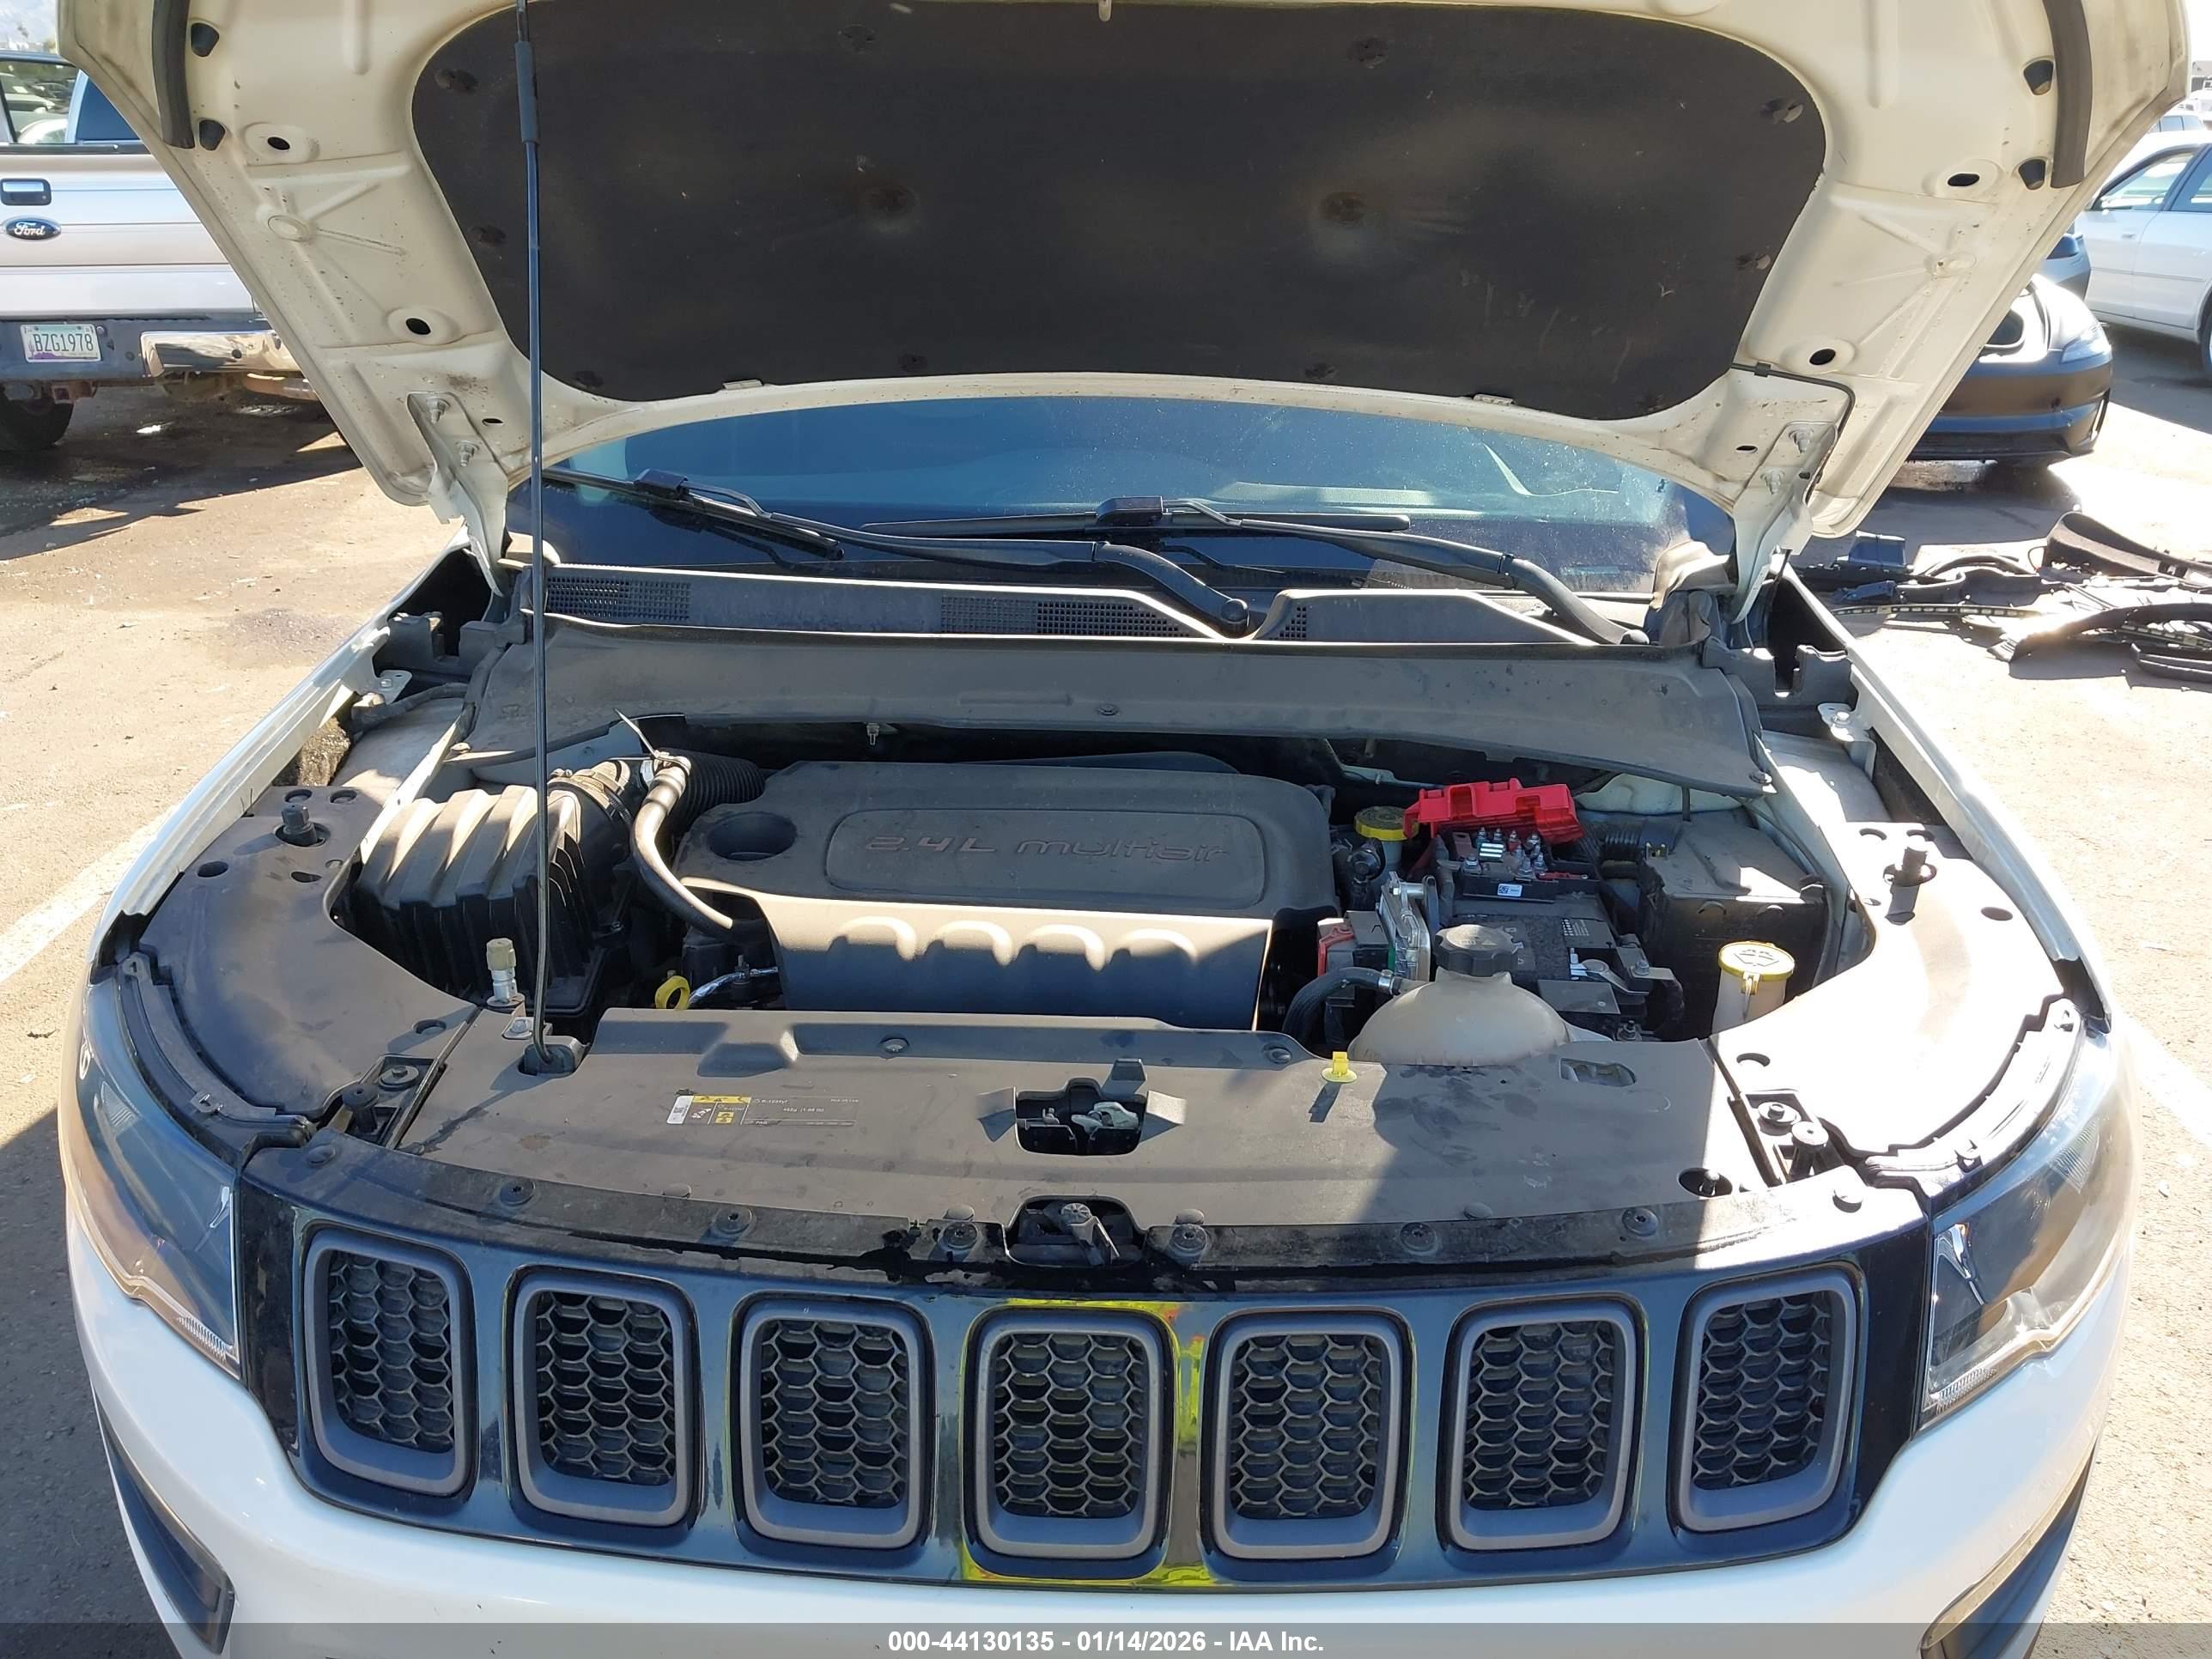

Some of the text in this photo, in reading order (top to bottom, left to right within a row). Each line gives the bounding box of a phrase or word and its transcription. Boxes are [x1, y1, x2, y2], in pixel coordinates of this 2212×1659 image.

[14, 221, 46, 236] Ford
[33, 333, 94, 351] BZG1978
[1017, 838, 1227, 861] multiair
